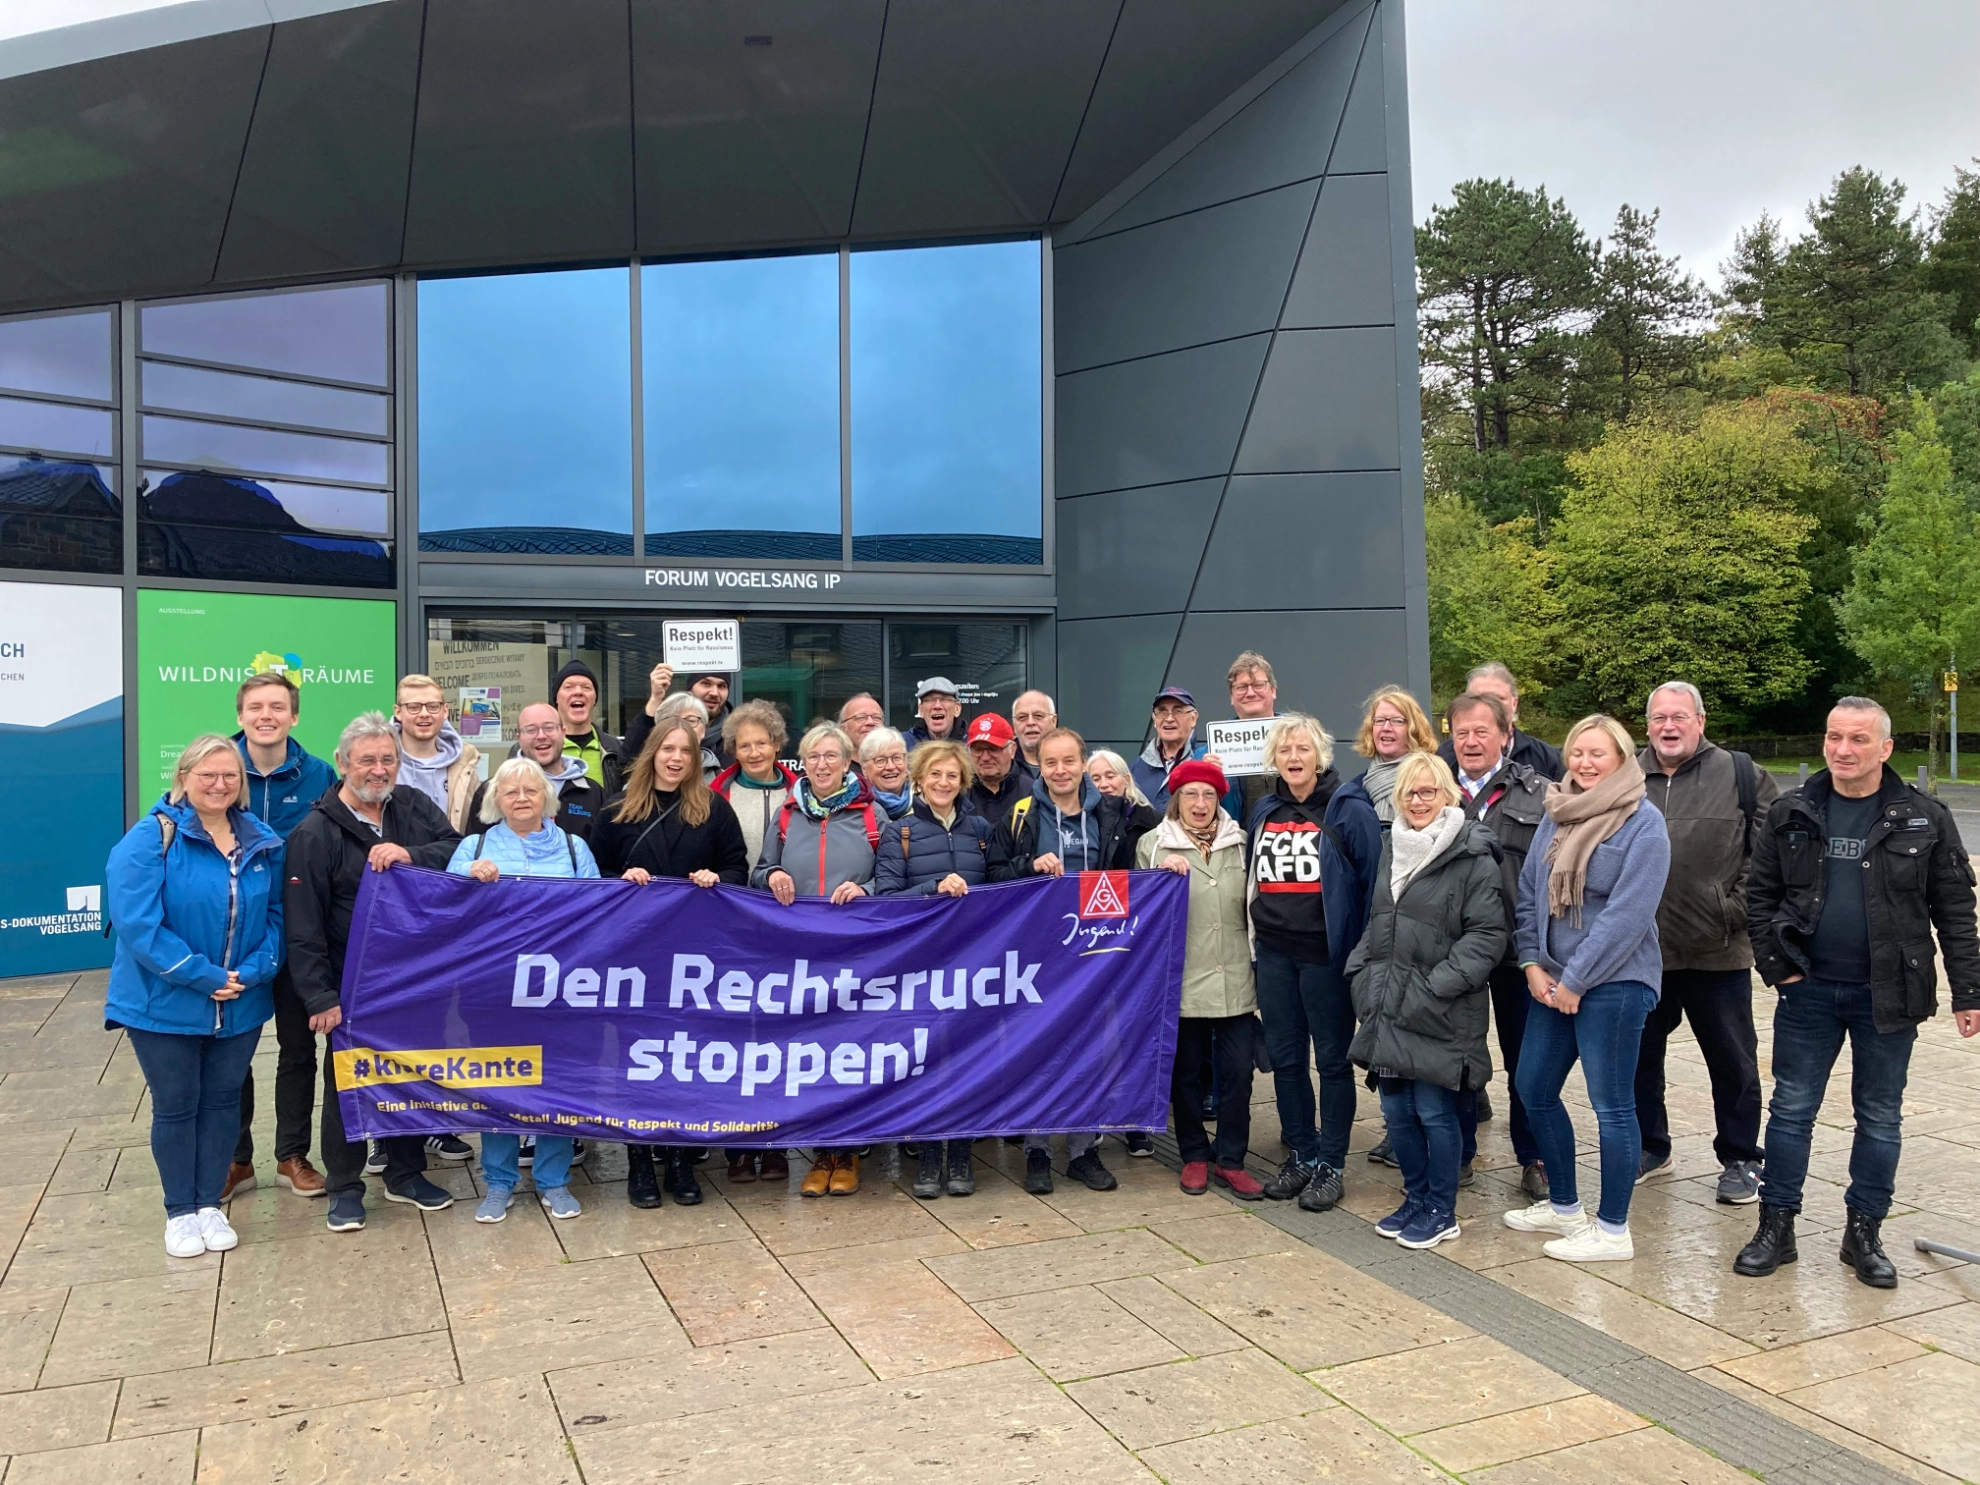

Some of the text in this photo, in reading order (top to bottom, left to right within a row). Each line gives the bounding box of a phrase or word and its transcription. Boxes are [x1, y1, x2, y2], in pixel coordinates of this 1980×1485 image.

[645, 570, 841, 589] FORUM VOGELSANG IP
[158, 607, 206, 615] AUSSTELLUNG
[443, 640, 500, 655] WILLKOMMEN
[669, 626, 733, 644] Respekt!
[1256, 831, 1320, 856] FCK
[1256, 855, 1321, 882] AFD
[40, 922, 102, 935] VOGELSANG
[1061, 912, 1139, 949] Jugend!
[511, 950, 1043, 1014] Den Rechtsruck
[627, 1027, 929, 1096] stoppen!
[377, 1101, 407, 1112] Eine
[410, 1100, 469, 1111] Initiative
[553, 1113, 602, 1126] Jugend
[605, 1117, 625, 1127] für
[628, 1119, 681, 1131] Respekt
[684, 1121, 709, 1132] und
